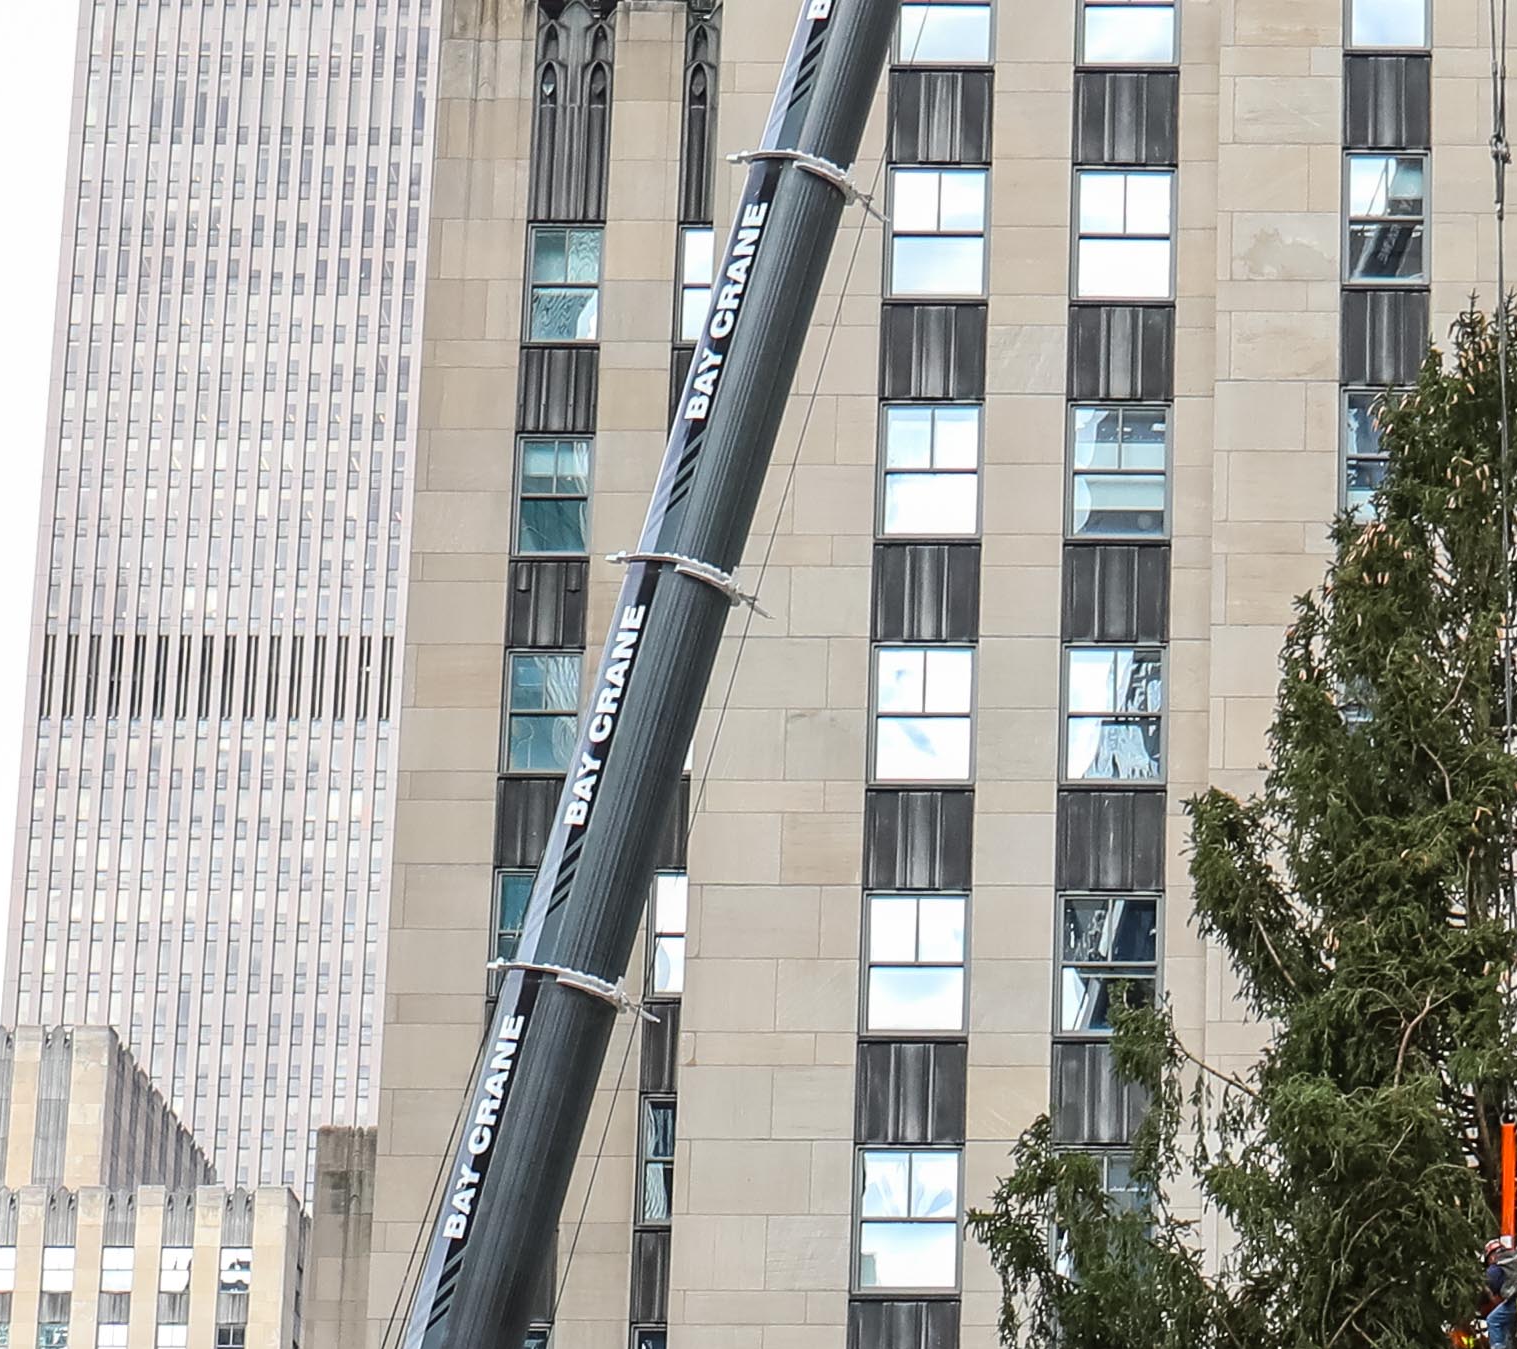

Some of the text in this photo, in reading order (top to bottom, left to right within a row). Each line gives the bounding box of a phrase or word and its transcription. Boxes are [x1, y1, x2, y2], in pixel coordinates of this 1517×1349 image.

[685, 202, 768, 420] BAY CRANE
[564, 605, 646, 825] BAY CRANE
[443, 1015, 525, 1239] BAY CRANE
